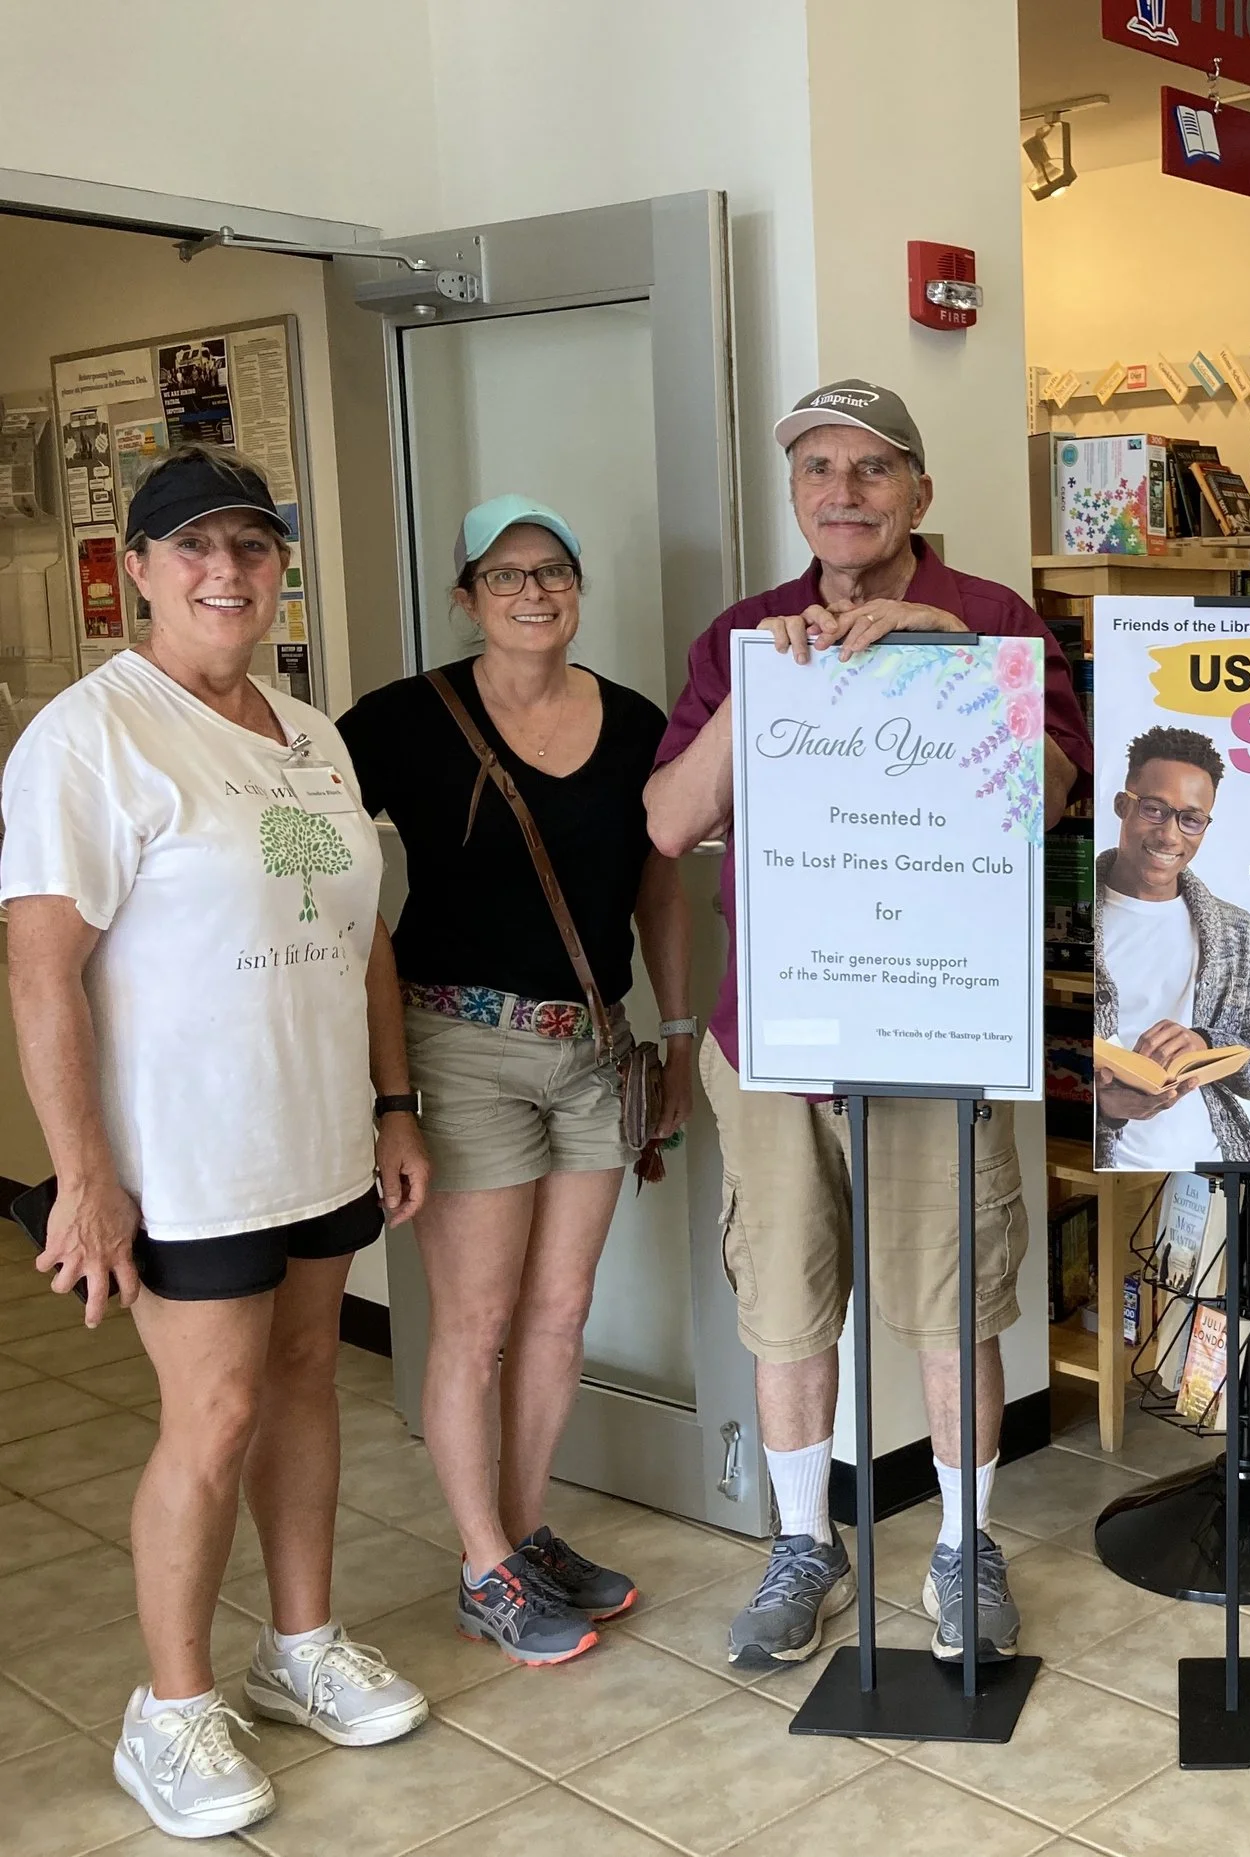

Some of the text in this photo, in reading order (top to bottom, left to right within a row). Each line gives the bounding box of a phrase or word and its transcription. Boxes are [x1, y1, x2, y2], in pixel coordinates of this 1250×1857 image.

[940, 310, 967, 324] FIRE
[1113, 618, 1169, 632] Friends
[1174, 618, 1189, 632] of
[1193, 619, 1216, 633] the
[756, 717, 957, 776] Thank You
[225, 780, 240, 796] A
[830, 807, 946, 827] Presented to
[763, 850, 1013, 875] The Lost Pines Garden Club
[875, 901, 903, 920] for
[236, 946, 280, 970] isn't
[284, 943, 301, 964] fit
[304, 942, 328, 963] for
[811, 950, 968, 970] Their generous support
[779, 967, 1000, 989] of the Summer Reading Program
[876, 1028, 1013, 1043] The Friends of the Bastrop Library
